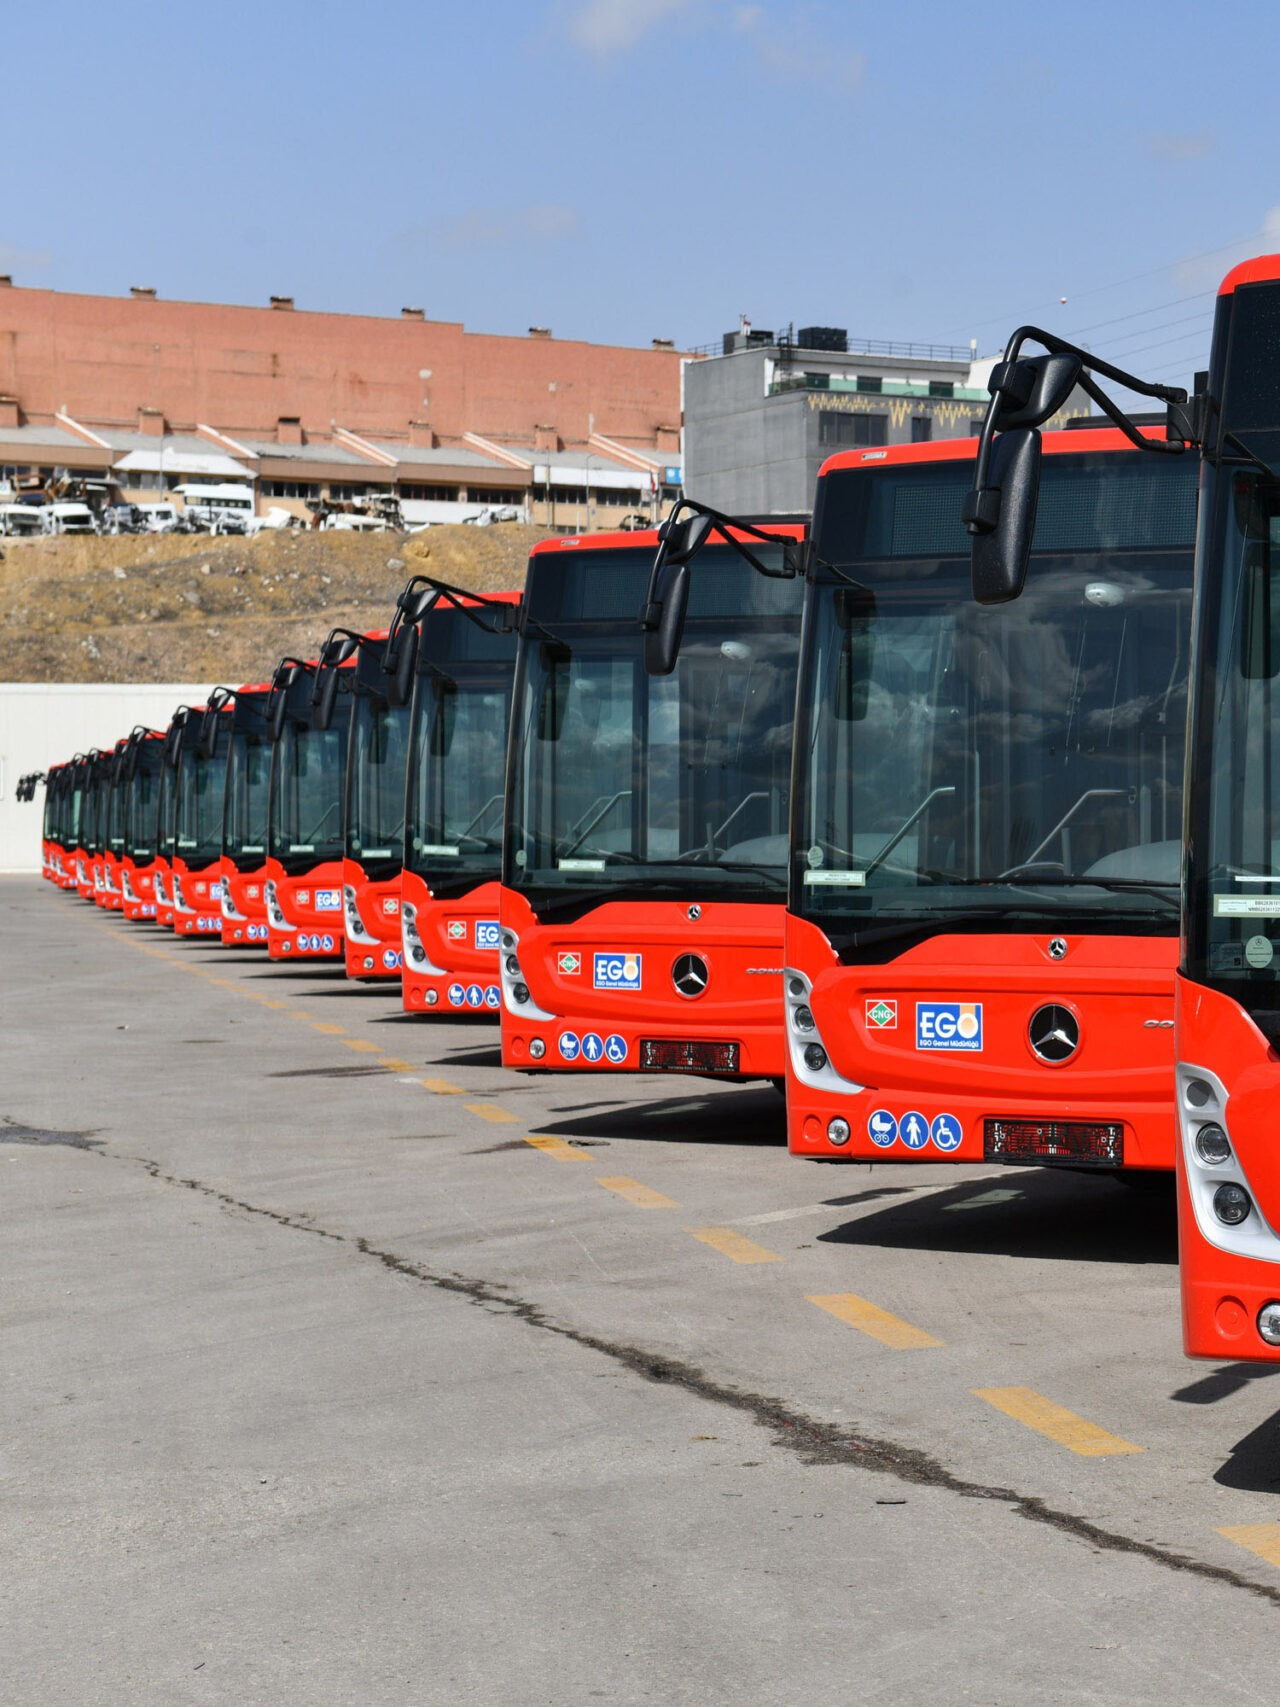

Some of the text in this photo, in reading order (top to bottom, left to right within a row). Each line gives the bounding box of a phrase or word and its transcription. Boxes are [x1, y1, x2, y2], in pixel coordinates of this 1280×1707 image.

[596, 959, 639, 981] EGO
[871, 1009, 891, 1019] CNG
[920, 1011, 979, 1039] EGO
